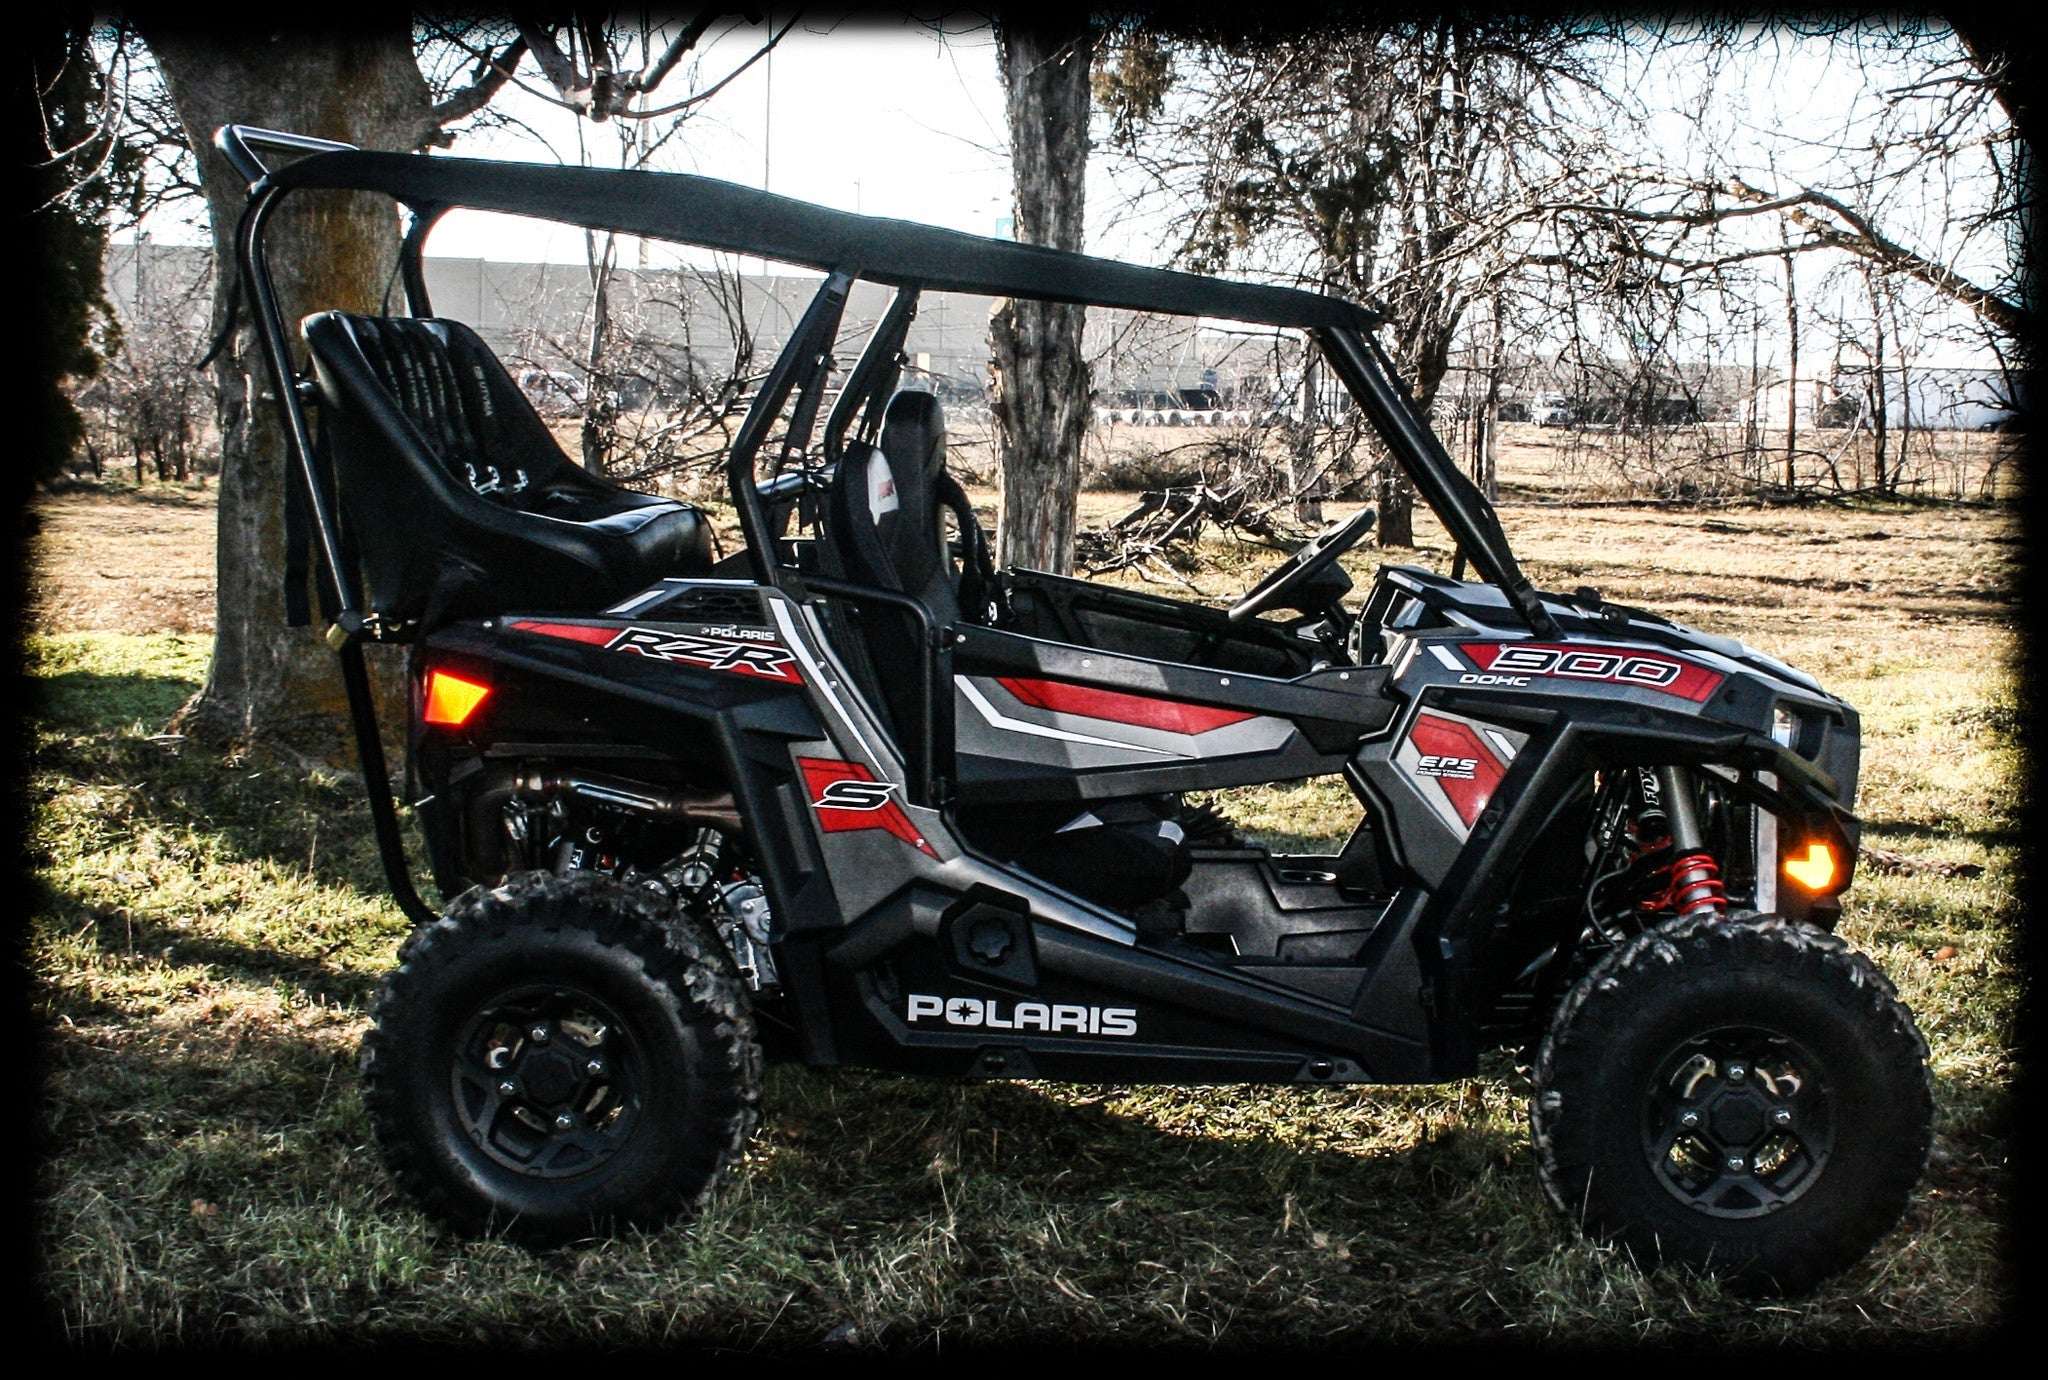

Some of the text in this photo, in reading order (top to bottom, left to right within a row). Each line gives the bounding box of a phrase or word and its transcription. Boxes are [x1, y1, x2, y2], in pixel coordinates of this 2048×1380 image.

[710, 627, 776, 641] POLARIS
[604, 627, 796, 677] RZR
[1486, 646, 1682, 687] 900
[1459, 673, 1531, 687] DOHC
[1418, 755, 1479, 771] EPS
[811, 781, 899, 810] S
[907, 994, 1137, 1036] POLARIS
